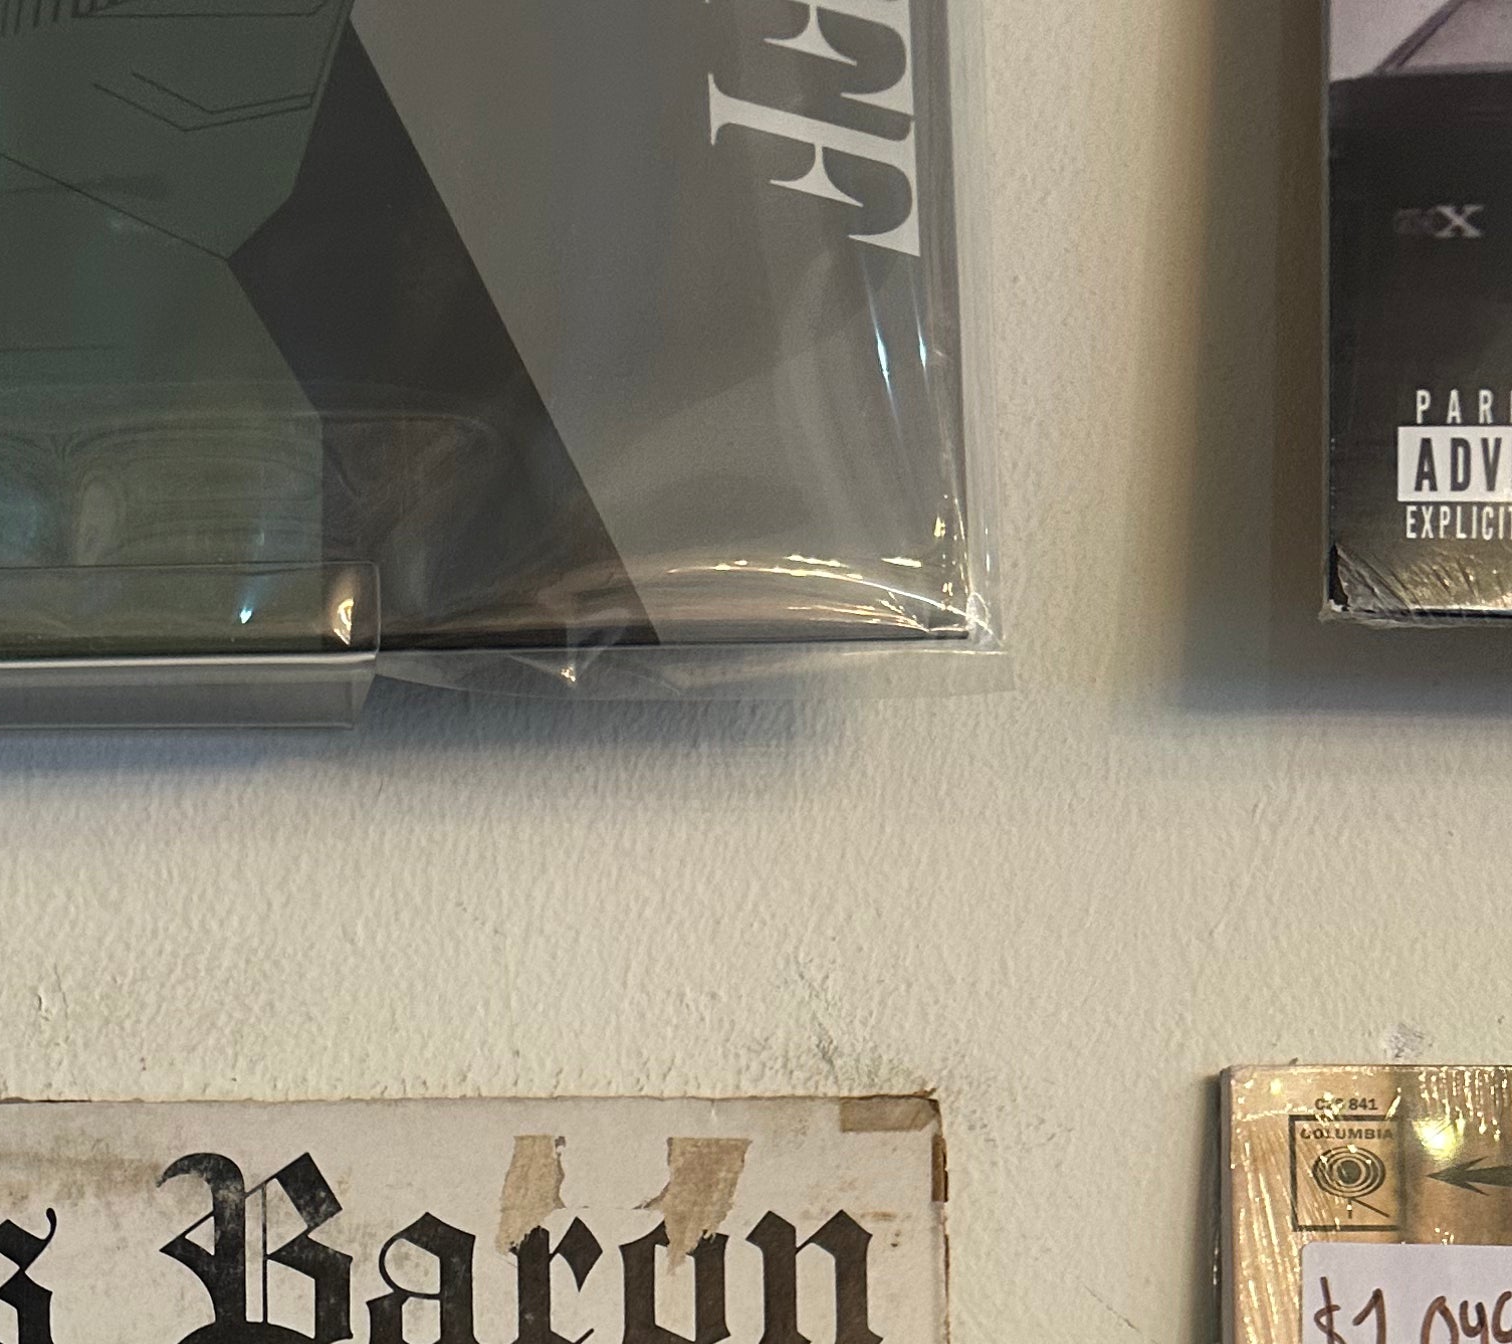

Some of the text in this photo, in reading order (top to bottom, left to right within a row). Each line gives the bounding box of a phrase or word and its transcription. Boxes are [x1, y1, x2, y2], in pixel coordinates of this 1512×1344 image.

[1416, 388, 1512, 424] PAR
[1414, 437, 1502, 492] ADV
[1349, 1099, 1378, 1110] 841
[1300, 1127, 1393, 1140] COLUMBIA
